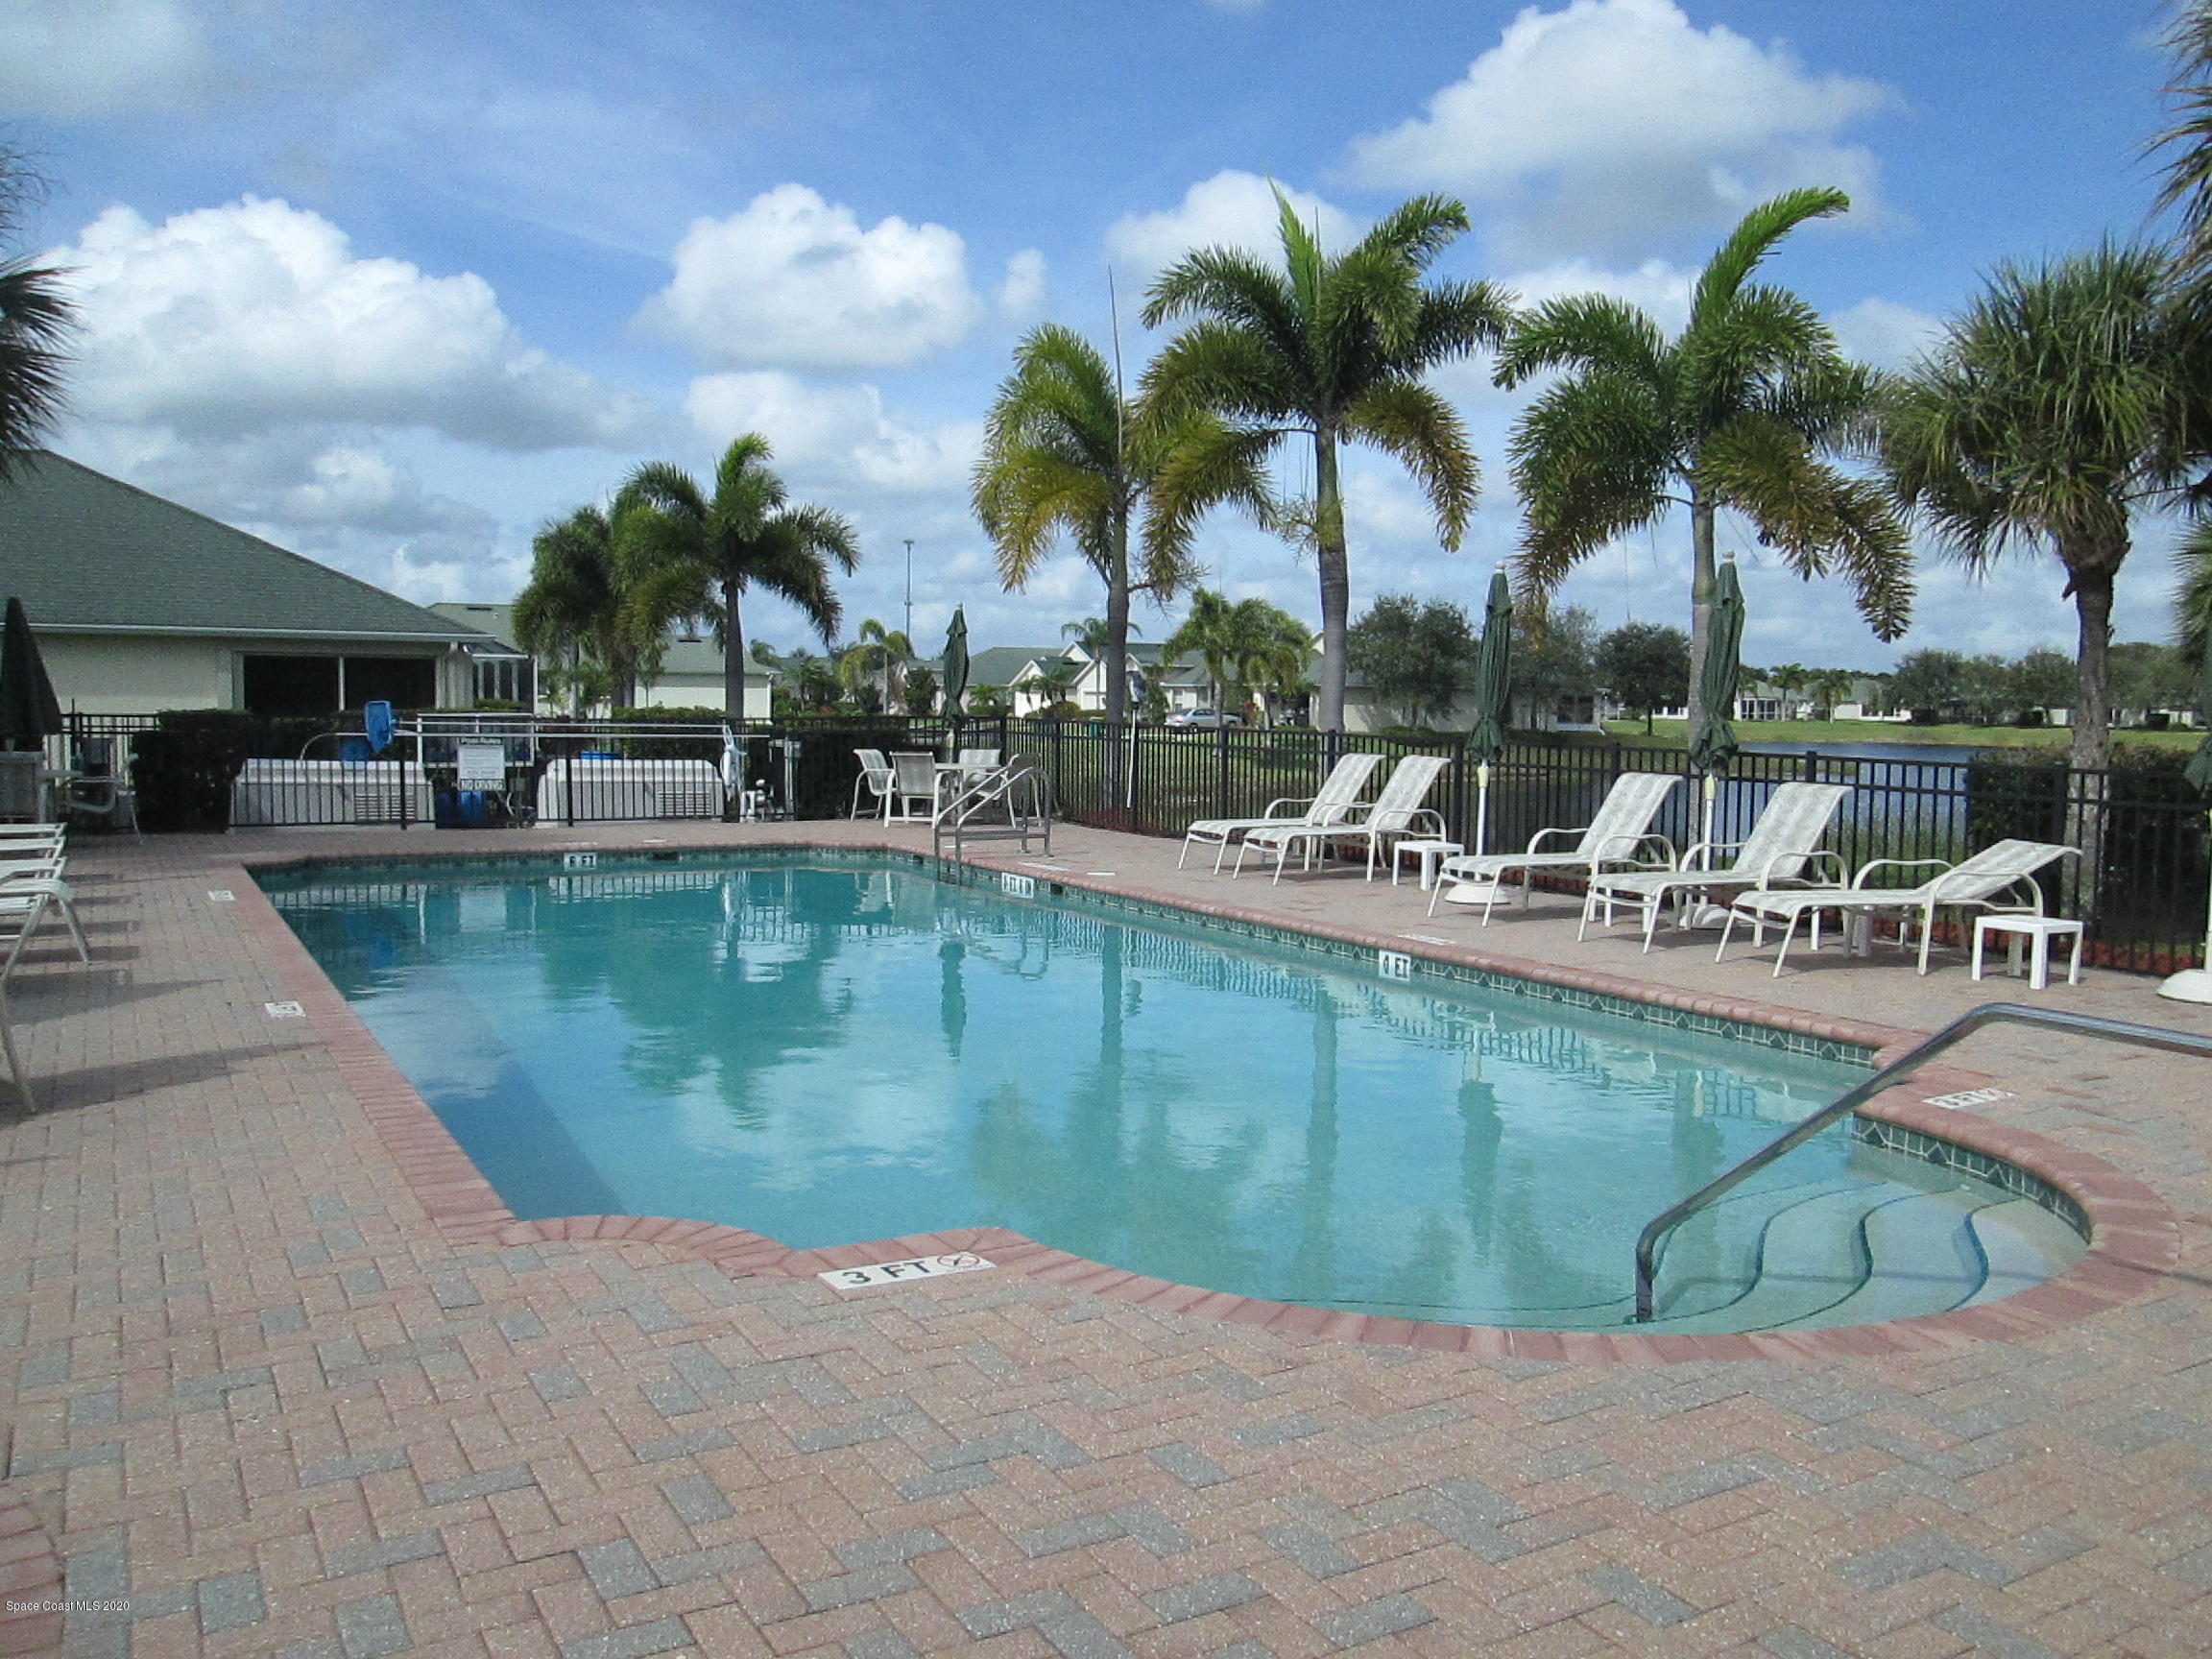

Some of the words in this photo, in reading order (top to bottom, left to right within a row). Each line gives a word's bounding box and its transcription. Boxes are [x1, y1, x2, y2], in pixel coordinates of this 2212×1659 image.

[461, 780, 473, 790] NO
[474, 780, 504, 790] DIVING
[582, 855, 594, 867] FT
[1395, 956, 1408, 978] FT
[842, 1271, 872, 1285] 3
[880, 1261, 930, 1278] FT
